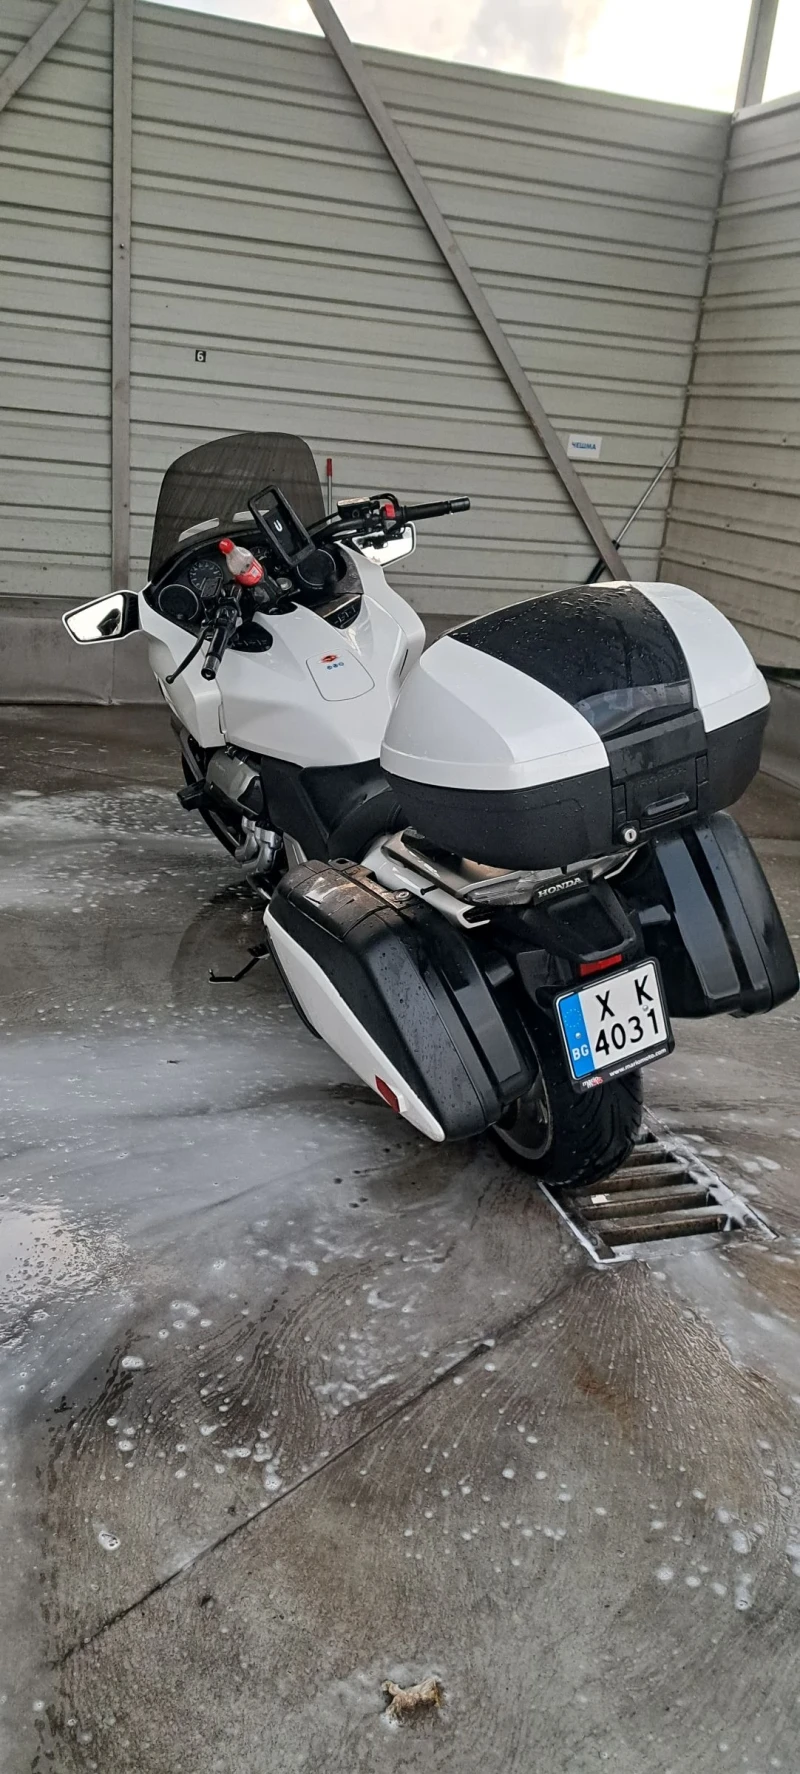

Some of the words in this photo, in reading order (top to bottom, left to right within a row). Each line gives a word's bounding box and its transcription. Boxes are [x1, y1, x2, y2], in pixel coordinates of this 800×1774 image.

[197, 350, 204, 361] 6
[538, 877, 583, 898] HONDA
[595, 989, 615, 1022] X
[633, 974, 654, 1006] K
[595, 1008, 659, 1056] 4031
[571, 1044, 589, 1061] BG
[608, 1047, 667, 1077] www.mariomoto.com
